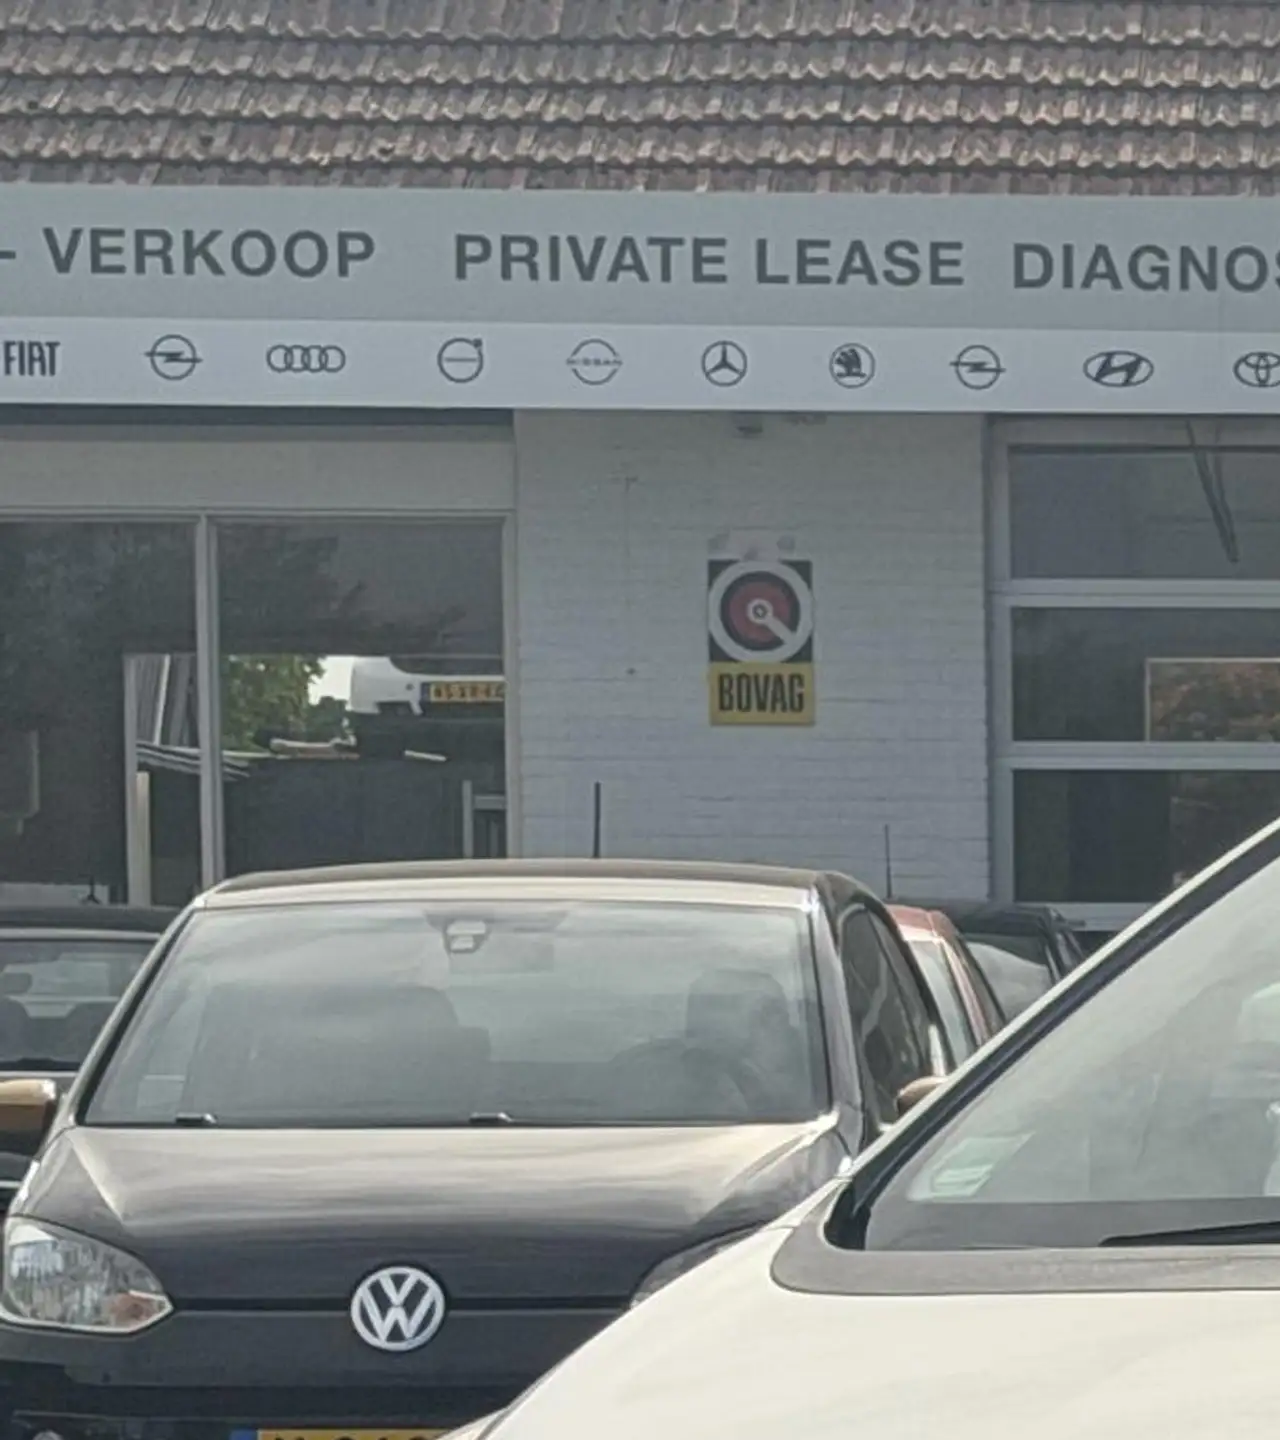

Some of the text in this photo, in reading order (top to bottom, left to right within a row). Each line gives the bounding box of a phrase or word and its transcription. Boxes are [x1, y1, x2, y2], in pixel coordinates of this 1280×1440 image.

[43, 228, 374, 277] VERKOOP
[456, 234, 964, 286] PRIVATE LEASE
[4, 341, 60, 376] FIAT
[718, 672, 805, 713] BOVAG
